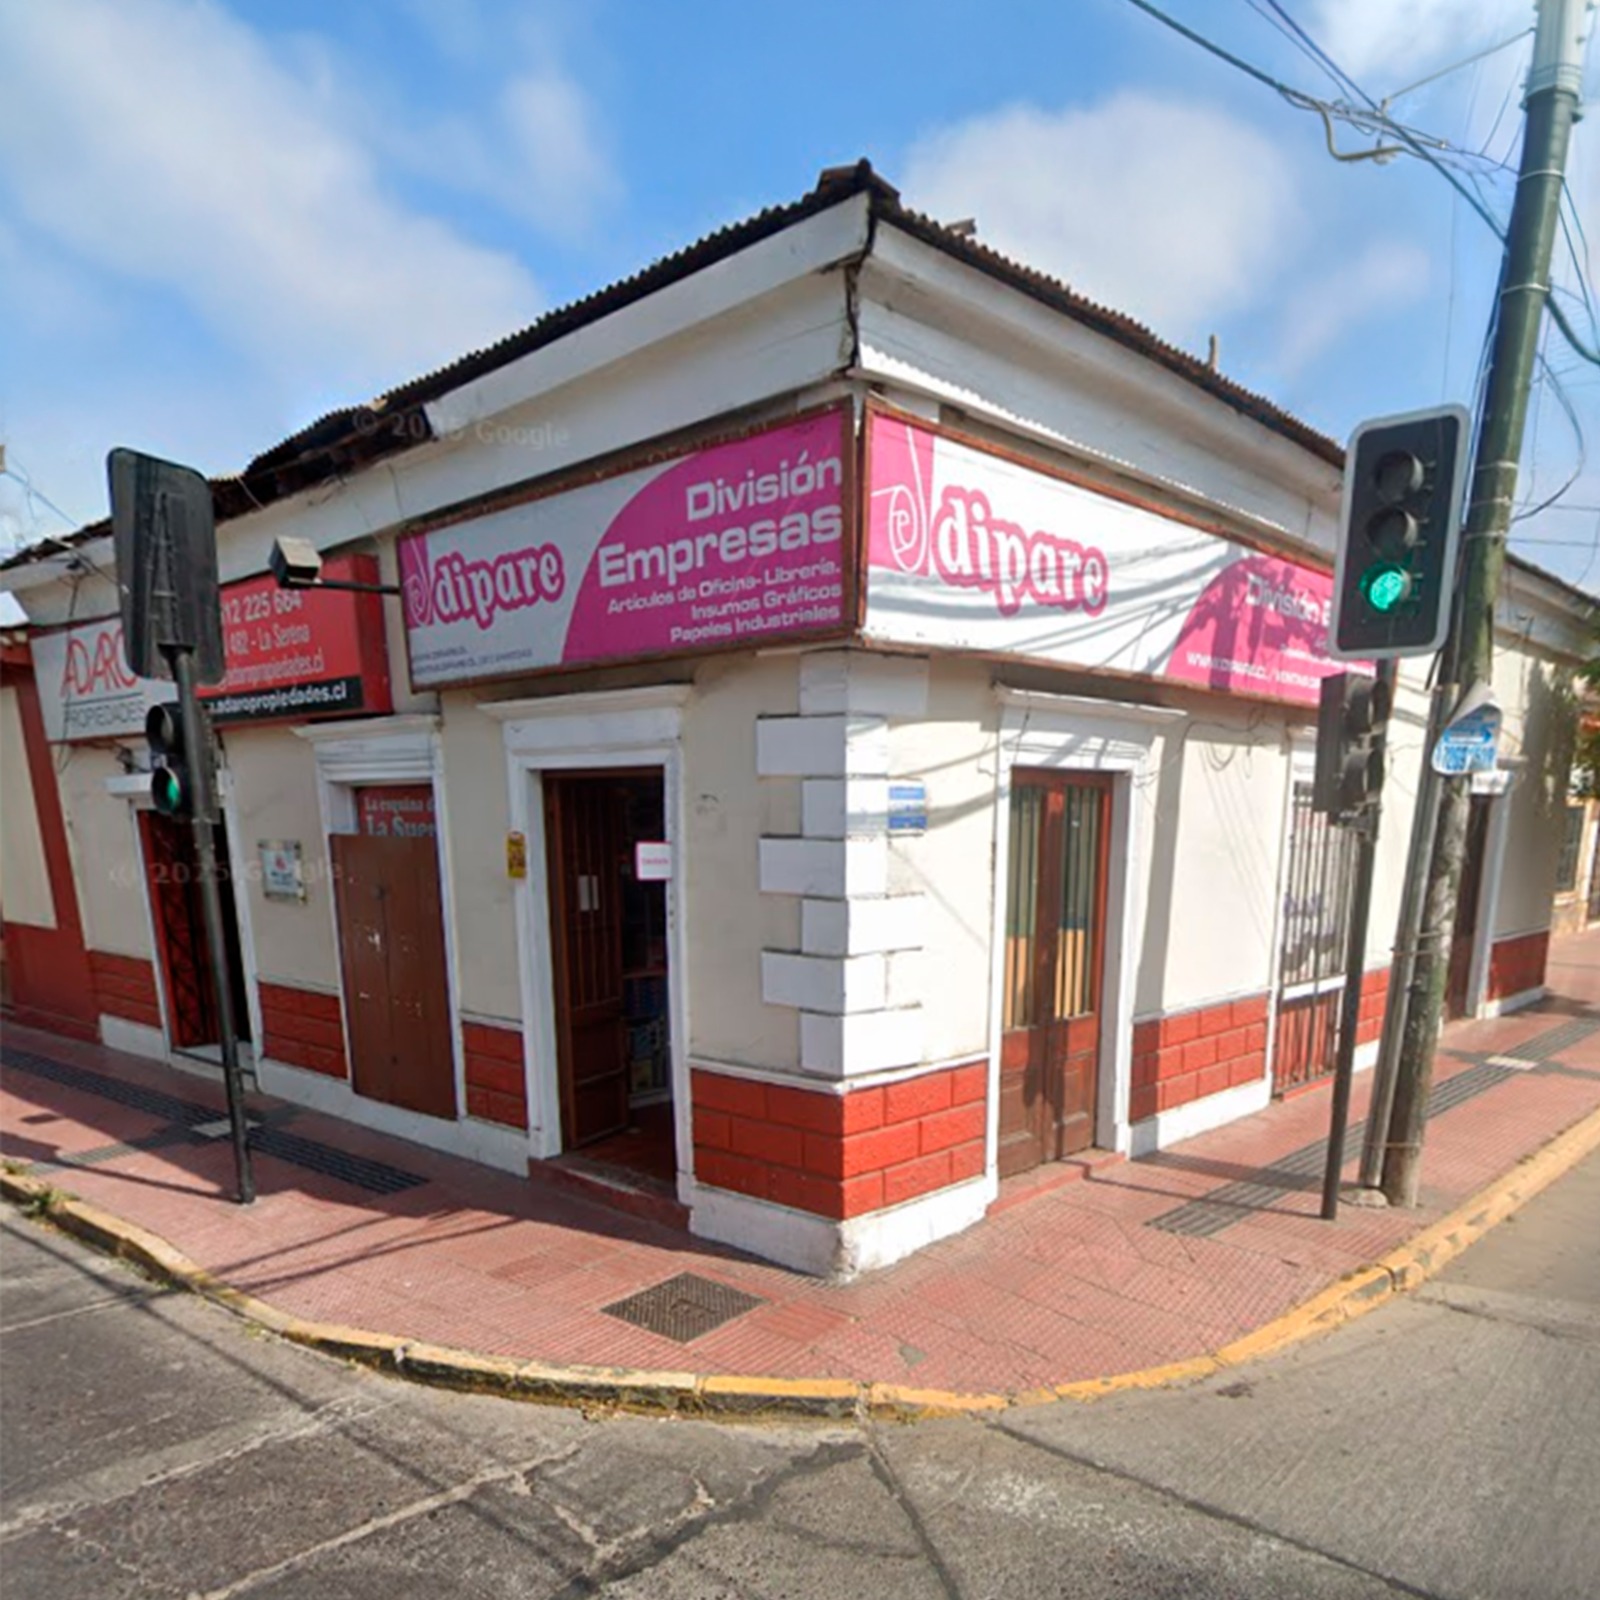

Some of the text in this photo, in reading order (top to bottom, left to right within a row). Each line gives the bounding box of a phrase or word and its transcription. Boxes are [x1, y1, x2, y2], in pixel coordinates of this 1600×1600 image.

[686, 451, 841, 521] División
[600, 505, 842, 586] Empresas
[935, 490, 1107, 613] dipare
[245, 591, 270, 621] 225
[433, 546, 563, 625] dipare
[607, 592, 674, 614] Artículos
[678, 587, 696, 602] de
[691, 582, 841, 619] Insumos Gráficos
[671, 604, 840, 643] Papeles Industriales
